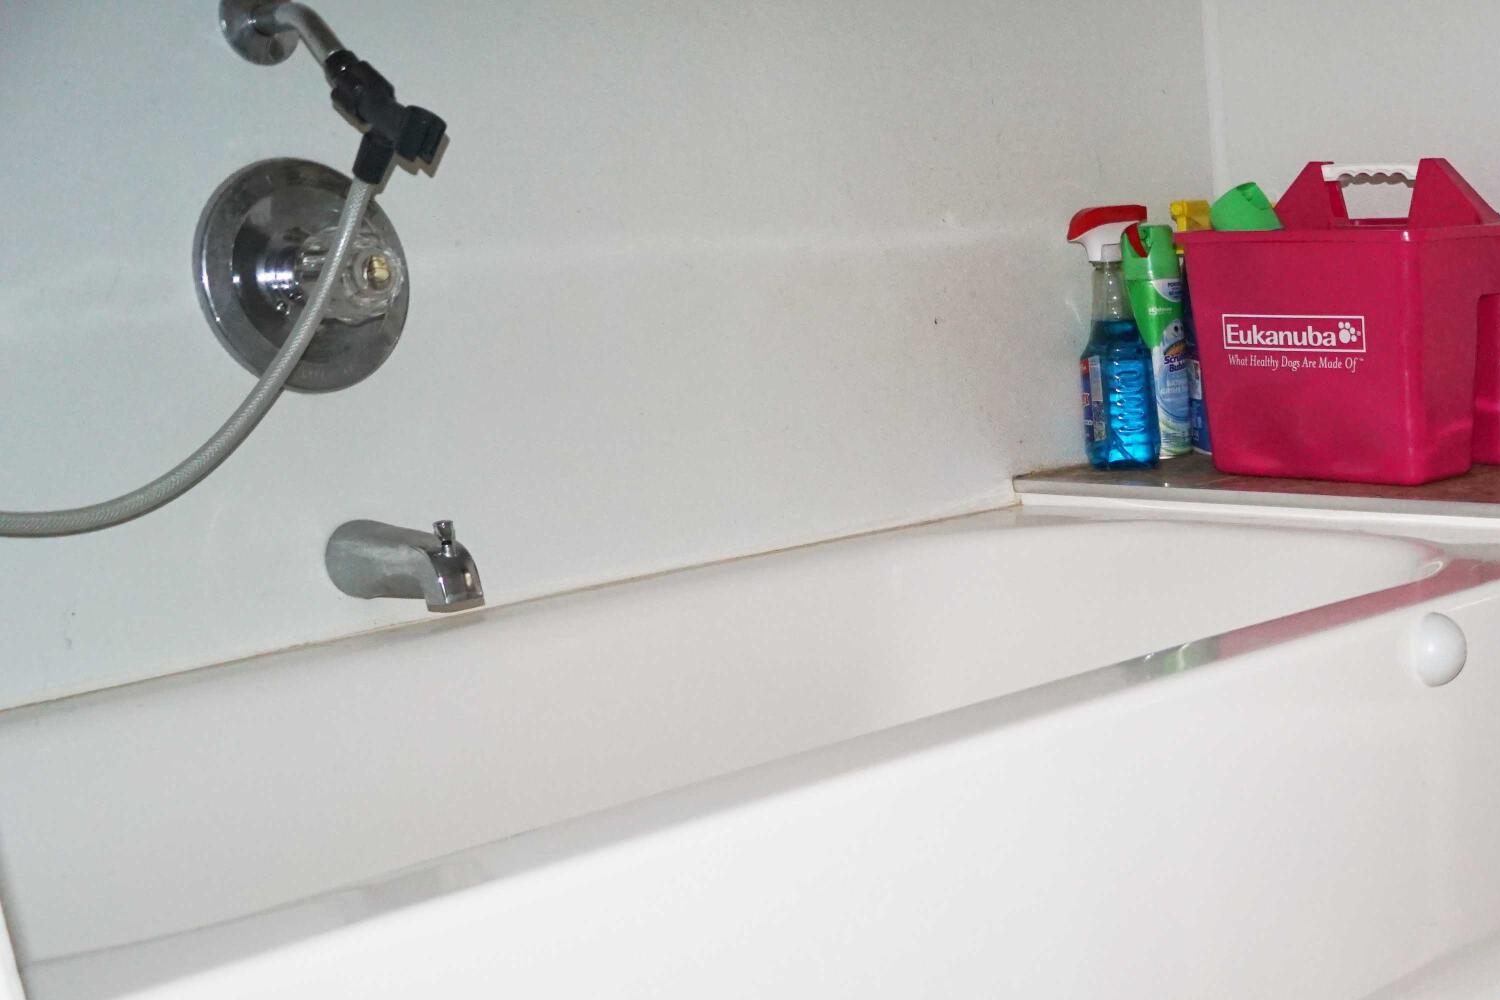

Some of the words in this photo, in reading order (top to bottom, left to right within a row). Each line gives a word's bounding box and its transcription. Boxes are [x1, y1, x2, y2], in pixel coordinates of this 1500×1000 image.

[1226, 323, 1337, 347] Eukanuba
[1228, 354, 1248, 366] What
[1250, 355, 1279, 371] Healthy
[1281, 356, 1300, 372] Dogs
[1302, 357, 1316, 368] Are
[1319, 357, 1342, 369] Made
[1345, 357, 1359, 373] Of
